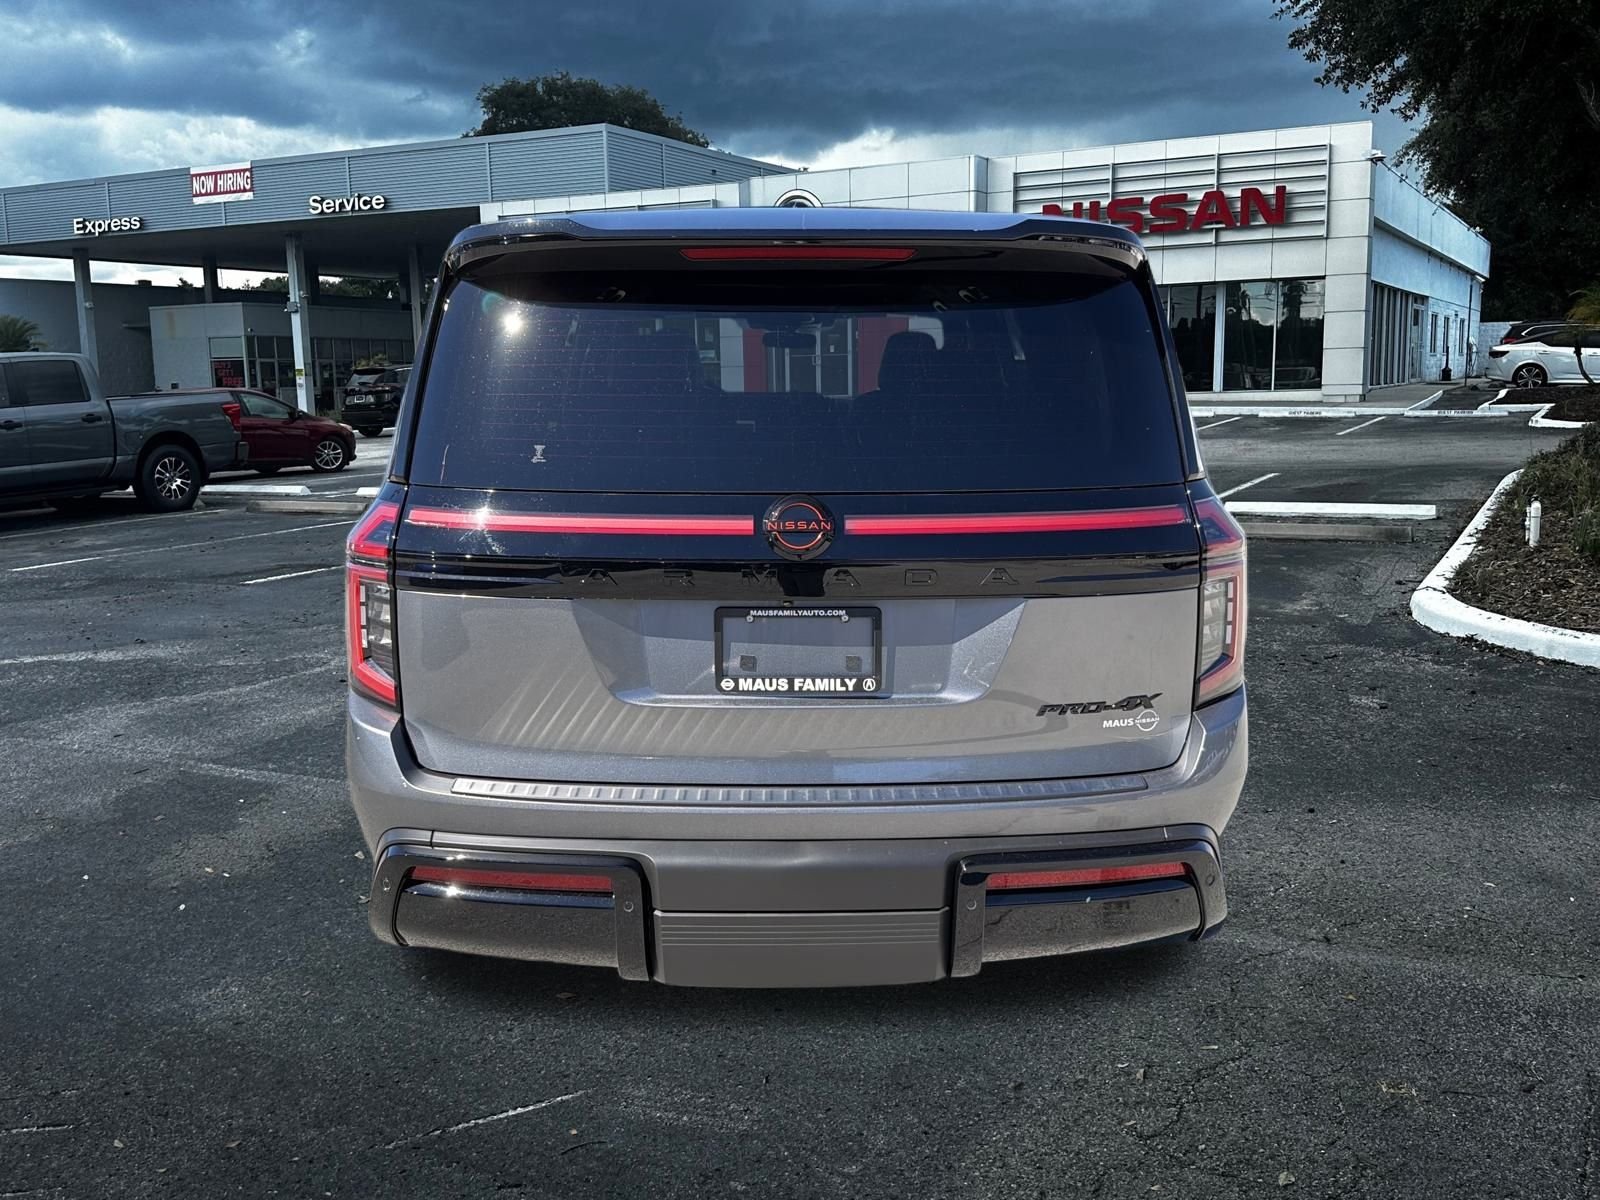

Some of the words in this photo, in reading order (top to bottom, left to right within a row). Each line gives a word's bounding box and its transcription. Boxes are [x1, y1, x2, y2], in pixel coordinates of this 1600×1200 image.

[192, 174, 215, 195] NOW
[217, 171, 251, 192] HIRING
[309, 193, 385, 214] Service
[73, 216, 141, 236] Express
[767, 521, 832, 531] NISSAN
[580, 567, 1020, 587] ARMADA
[750, 609, 847, 617] MAUSFAMILYAUTO.COM
[738, 678, 789, 692] MAUS
[793, 678, 857, 692] FAMILY
[1035, 692, 1163, 717] PRO-4X
[1103, 718, 1134, 728] MAUS
[1134, 716, 1160, 724] NISSAN
